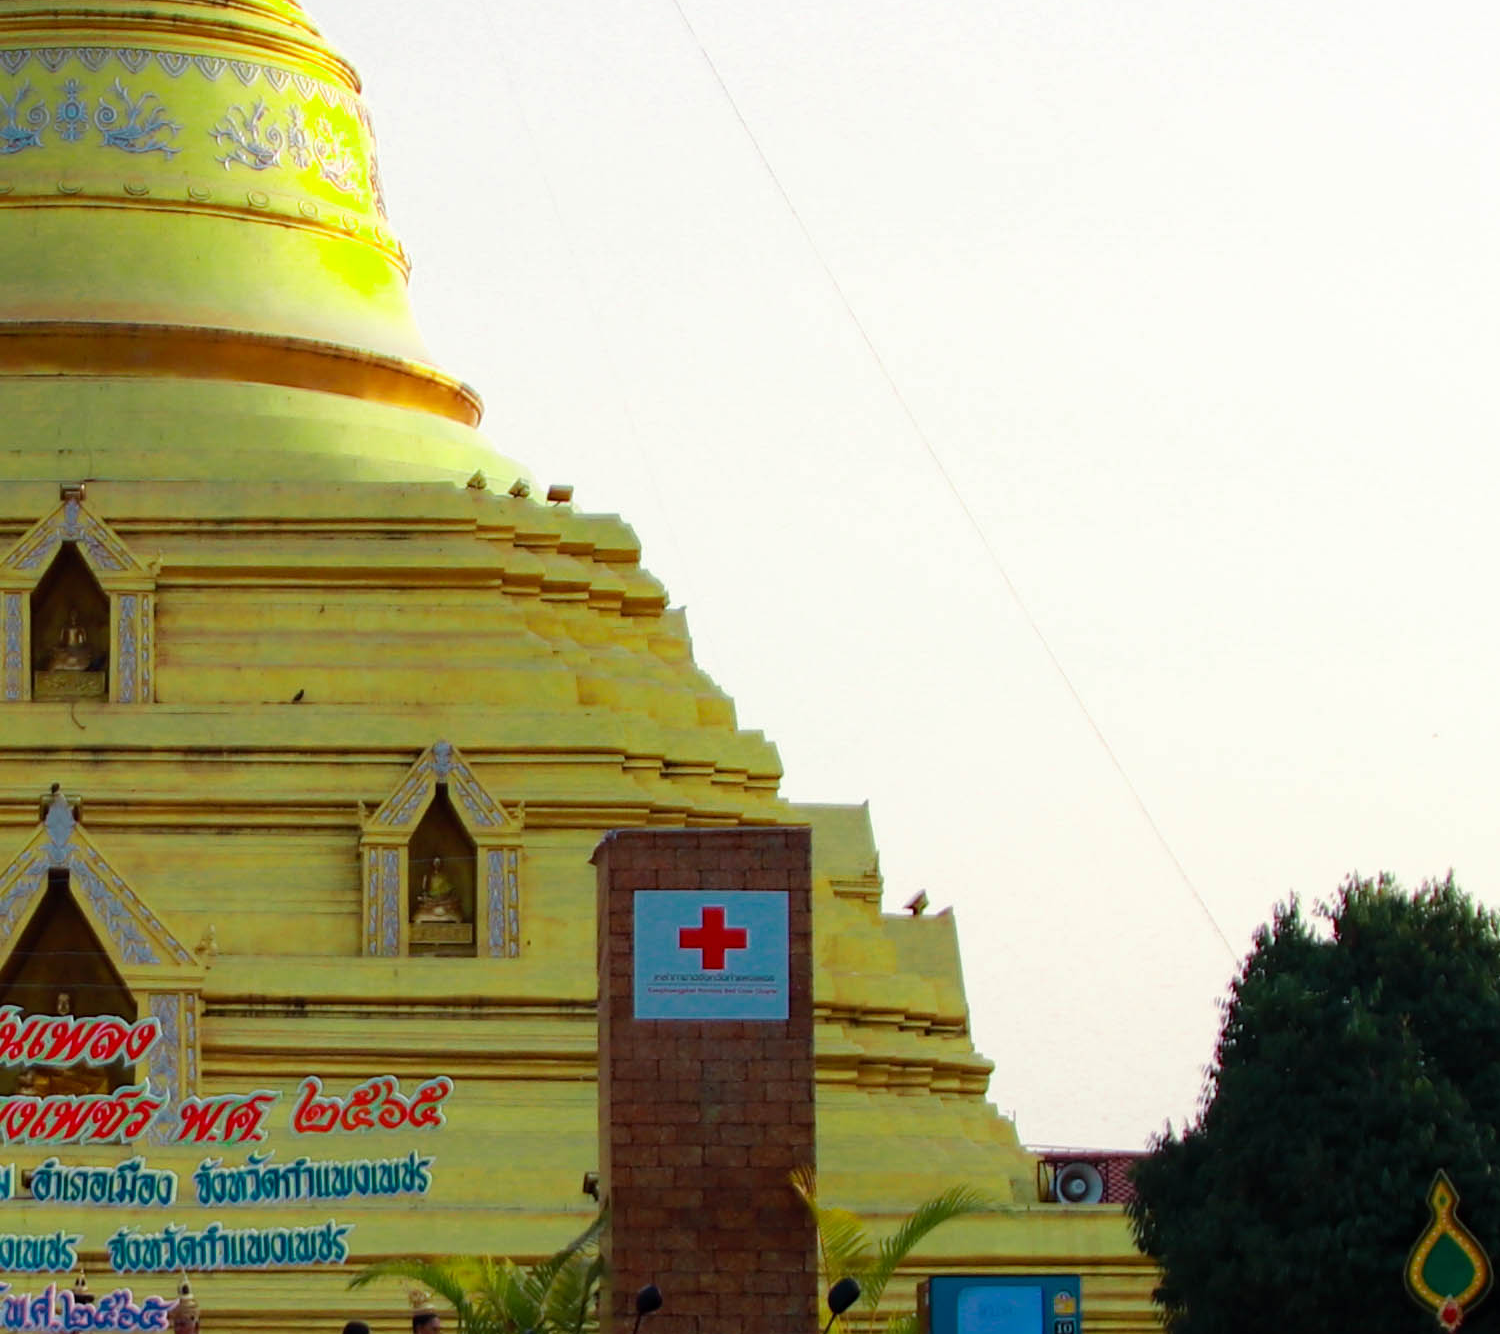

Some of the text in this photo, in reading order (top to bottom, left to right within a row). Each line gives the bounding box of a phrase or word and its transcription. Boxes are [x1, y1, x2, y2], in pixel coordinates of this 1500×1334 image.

[180, 1093, 281, 1143] พ.ศ.
[294, 1078, 452, 1131] ๒๕๖๕
[31, 1157, 176, 1205] อำเภอเมือง
[194, 1151, 435, 1205] จังหวัดกำแพงเพชร
[109, 1221, 353, 1271] จังหวัดกำแพงเพชร
